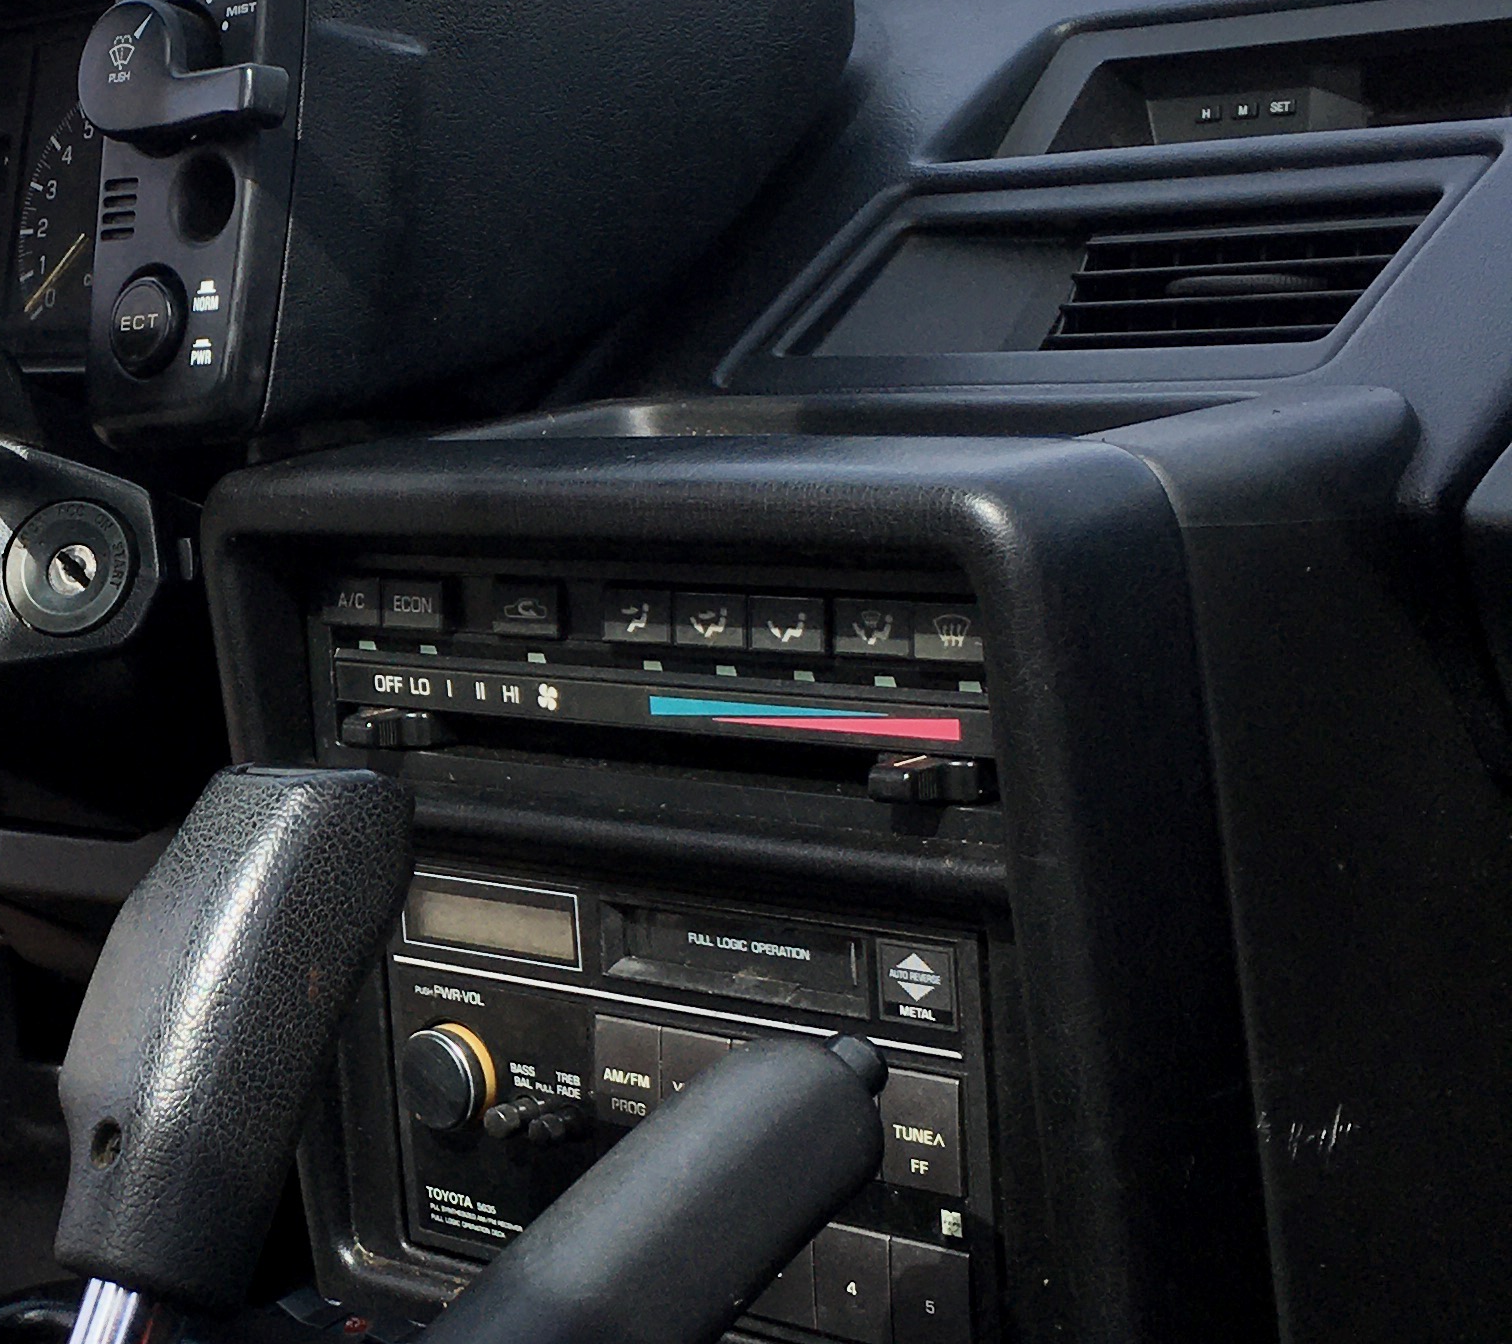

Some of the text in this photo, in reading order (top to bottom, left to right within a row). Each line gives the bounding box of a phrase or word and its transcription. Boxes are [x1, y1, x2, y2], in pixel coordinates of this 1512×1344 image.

[226, 2, 257, 17] MIST
[108, 71, 131, 83] PUSH
[1201, 108, 1211, 119] H
[1237, 104, 1248, 116] M
[1269, 100, 1291, 113] SET
[83, 122, 94, 139] 5
[61, 145, 73, 164] 4
[46, 179, 58, 200] 3
[37, 218, 49, 238] 2
[39, 255, 46, 274] 1
[44, 288, 56, 307] 0
[192, 295, 219, 312] NORM
[120, 313, 159, 331] ECT
[190, 349, 212, 366] PWR
[109, 541, 126, 591] START
[338, 593, 365, 609] A/C
[393, 595, 432, 613] ECON
[374, 674, 403, 694] OFF
[409, 677, 431, 695] LO
[502, 684, 520, 704] HI
[688, 932, 811, 961] FULL LOGIC OPERATION
[889, 968, 942, 986] AUTO REVERSE
[899, 1005, 936, 1021] METAL
[509, 1062, 536, 1077] BASS
[603, 1067, 651, 1089] AM/FM
[555, 1071, 581, 1086] TREB
[514, 1076, 581, 1100] BAL PULL FADE
[611, 1097, 647, 1117] PROG
[910, 1158, 929, 1174] FF
[426, 1185, 474, 1209] TOYOTA
[846, 1281, 858, 1296] 4
[925, 1300, 936, 1314] 5
